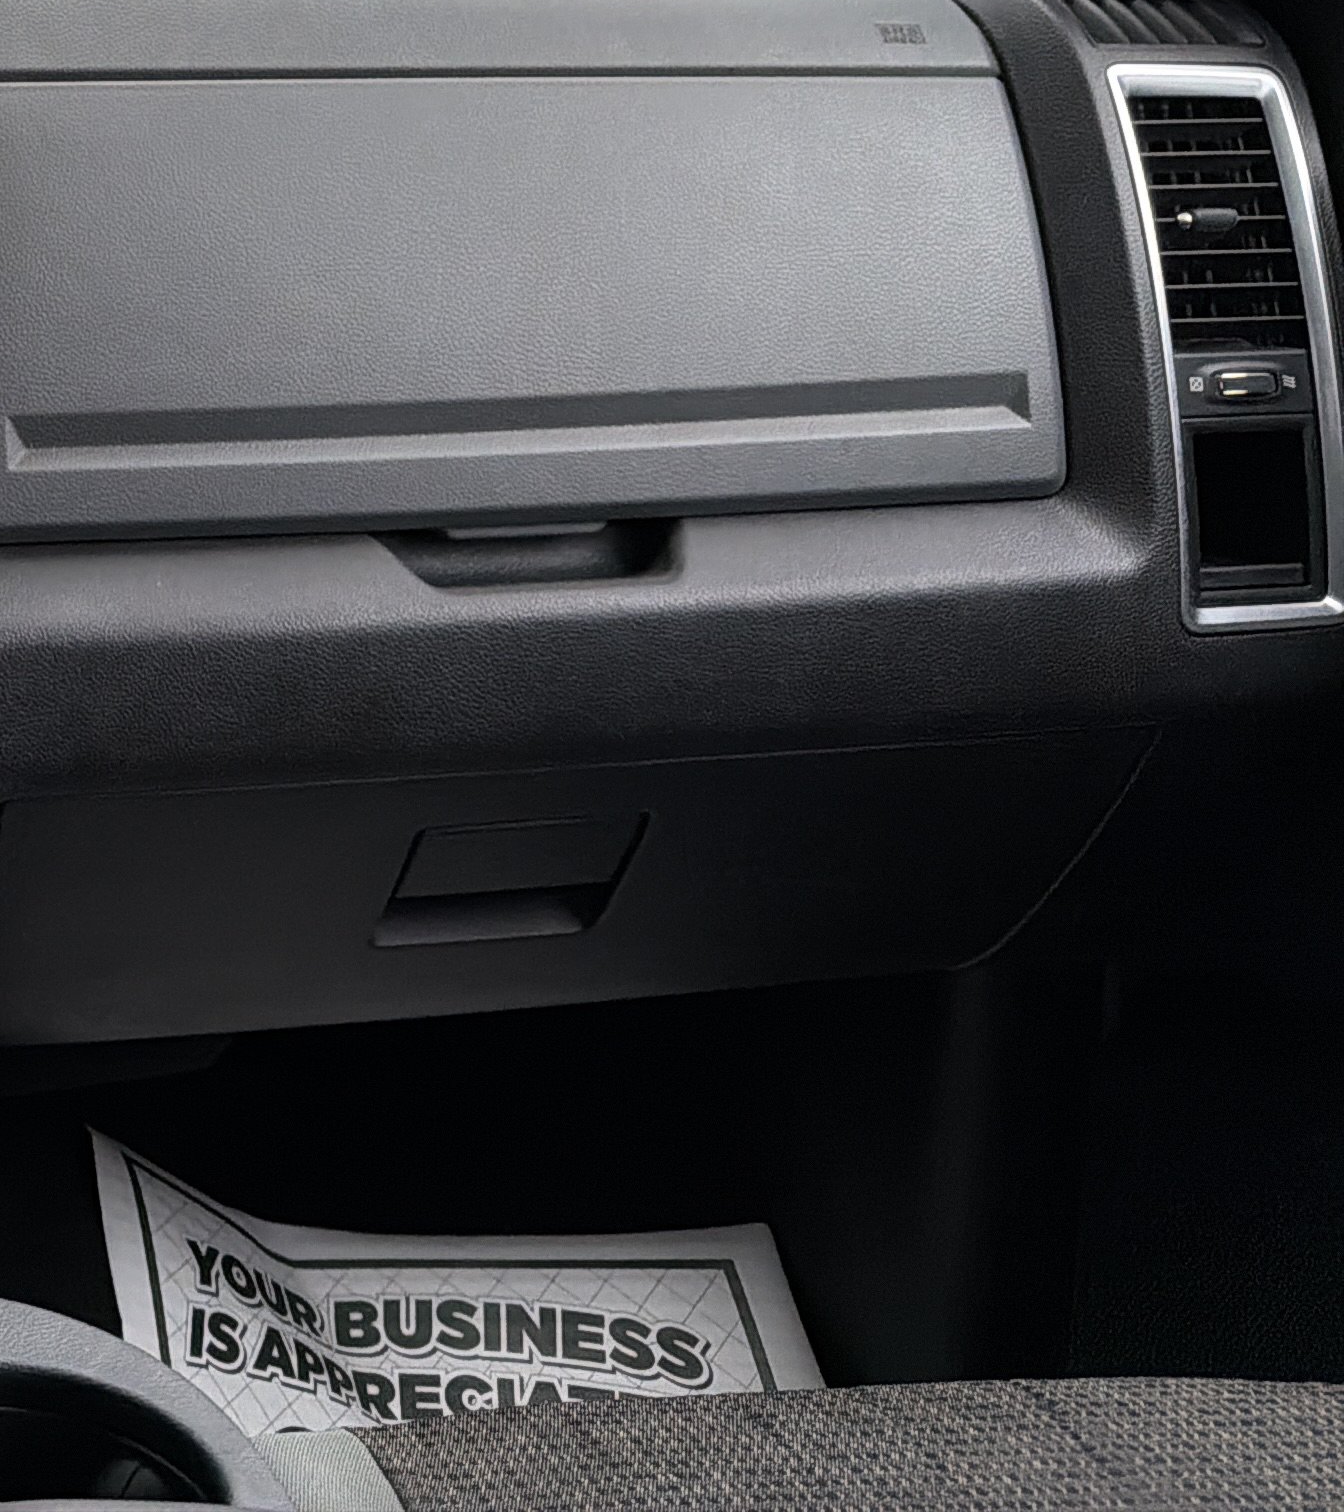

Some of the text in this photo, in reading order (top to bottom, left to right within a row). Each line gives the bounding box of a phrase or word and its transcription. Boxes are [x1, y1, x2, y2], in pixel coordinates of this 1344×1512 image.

[187, 1239, 712, 1385] YOUR BUSINESS
[189, 1307, 243, 1371] IS
